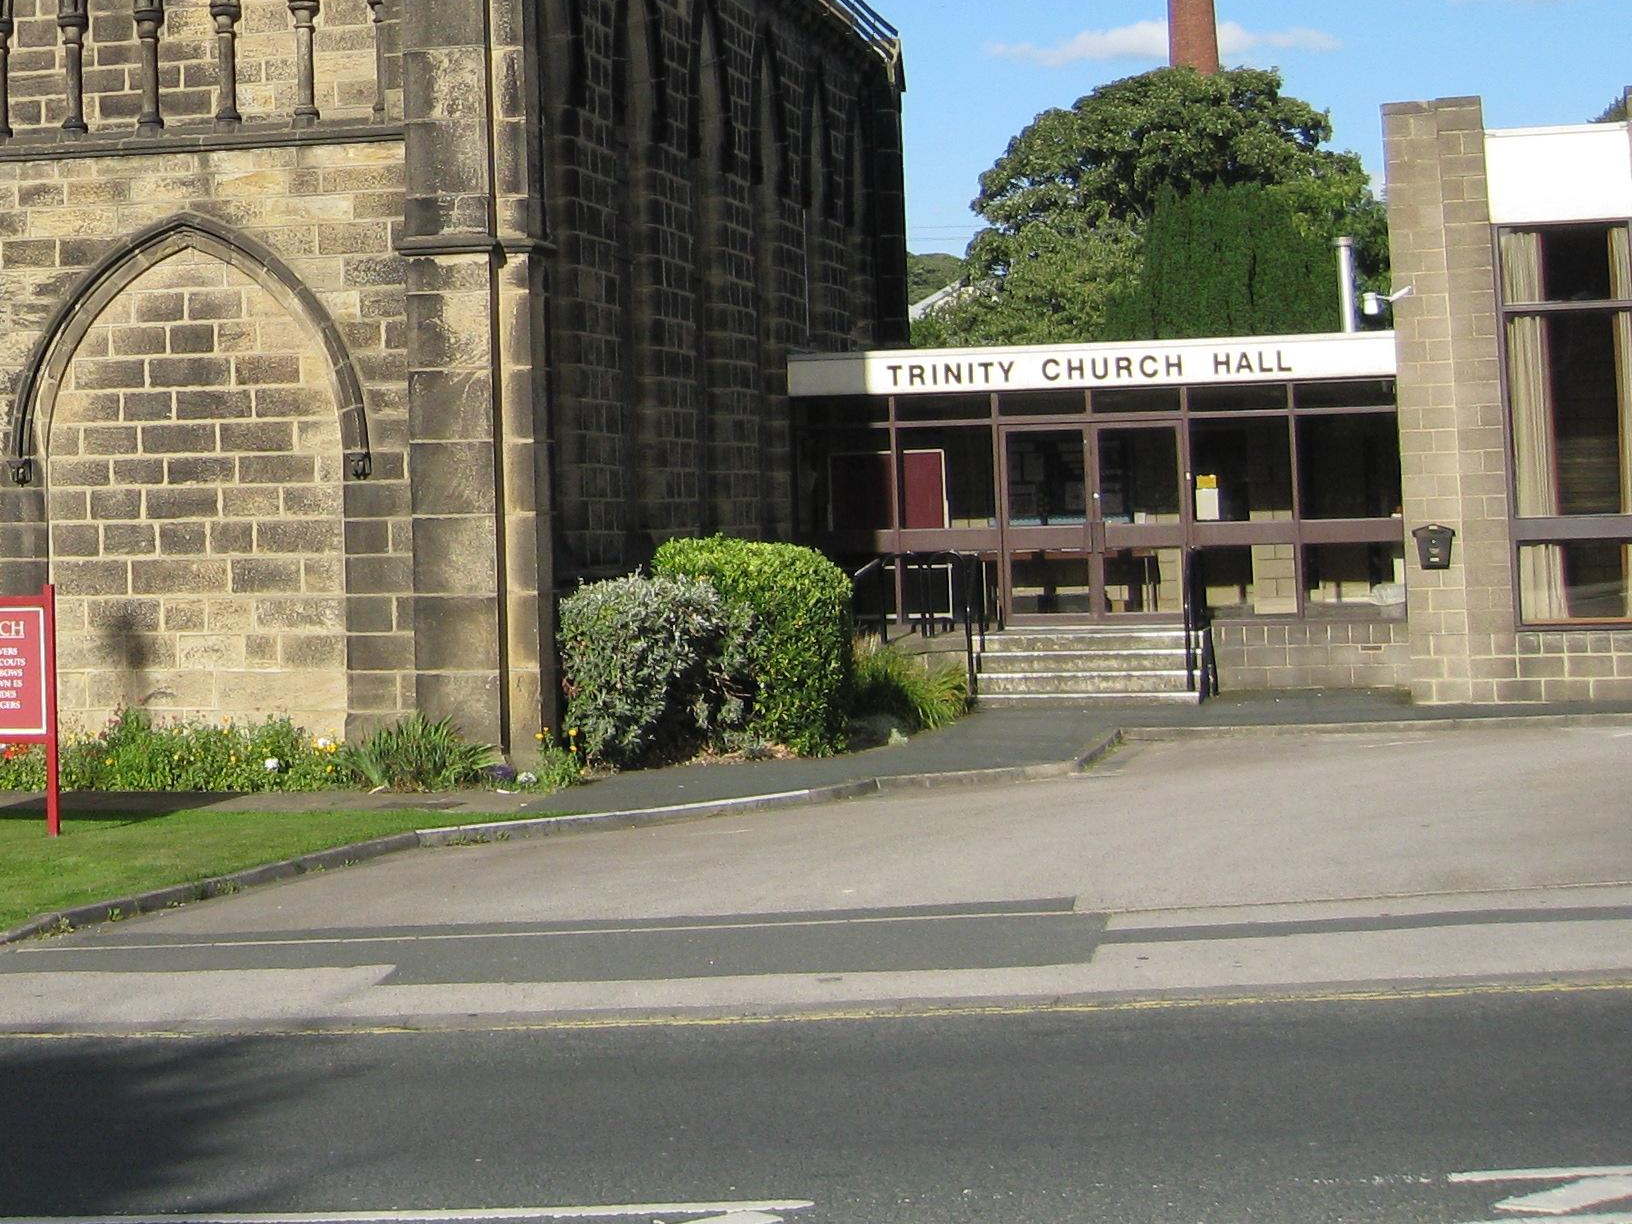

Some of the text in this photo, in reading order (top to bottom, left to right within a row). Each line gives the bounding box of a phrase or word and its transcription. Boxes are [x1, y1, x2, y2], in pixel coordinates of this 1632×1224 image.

[887, 350, 1292, 386] TRINITY CHURCH HALL
